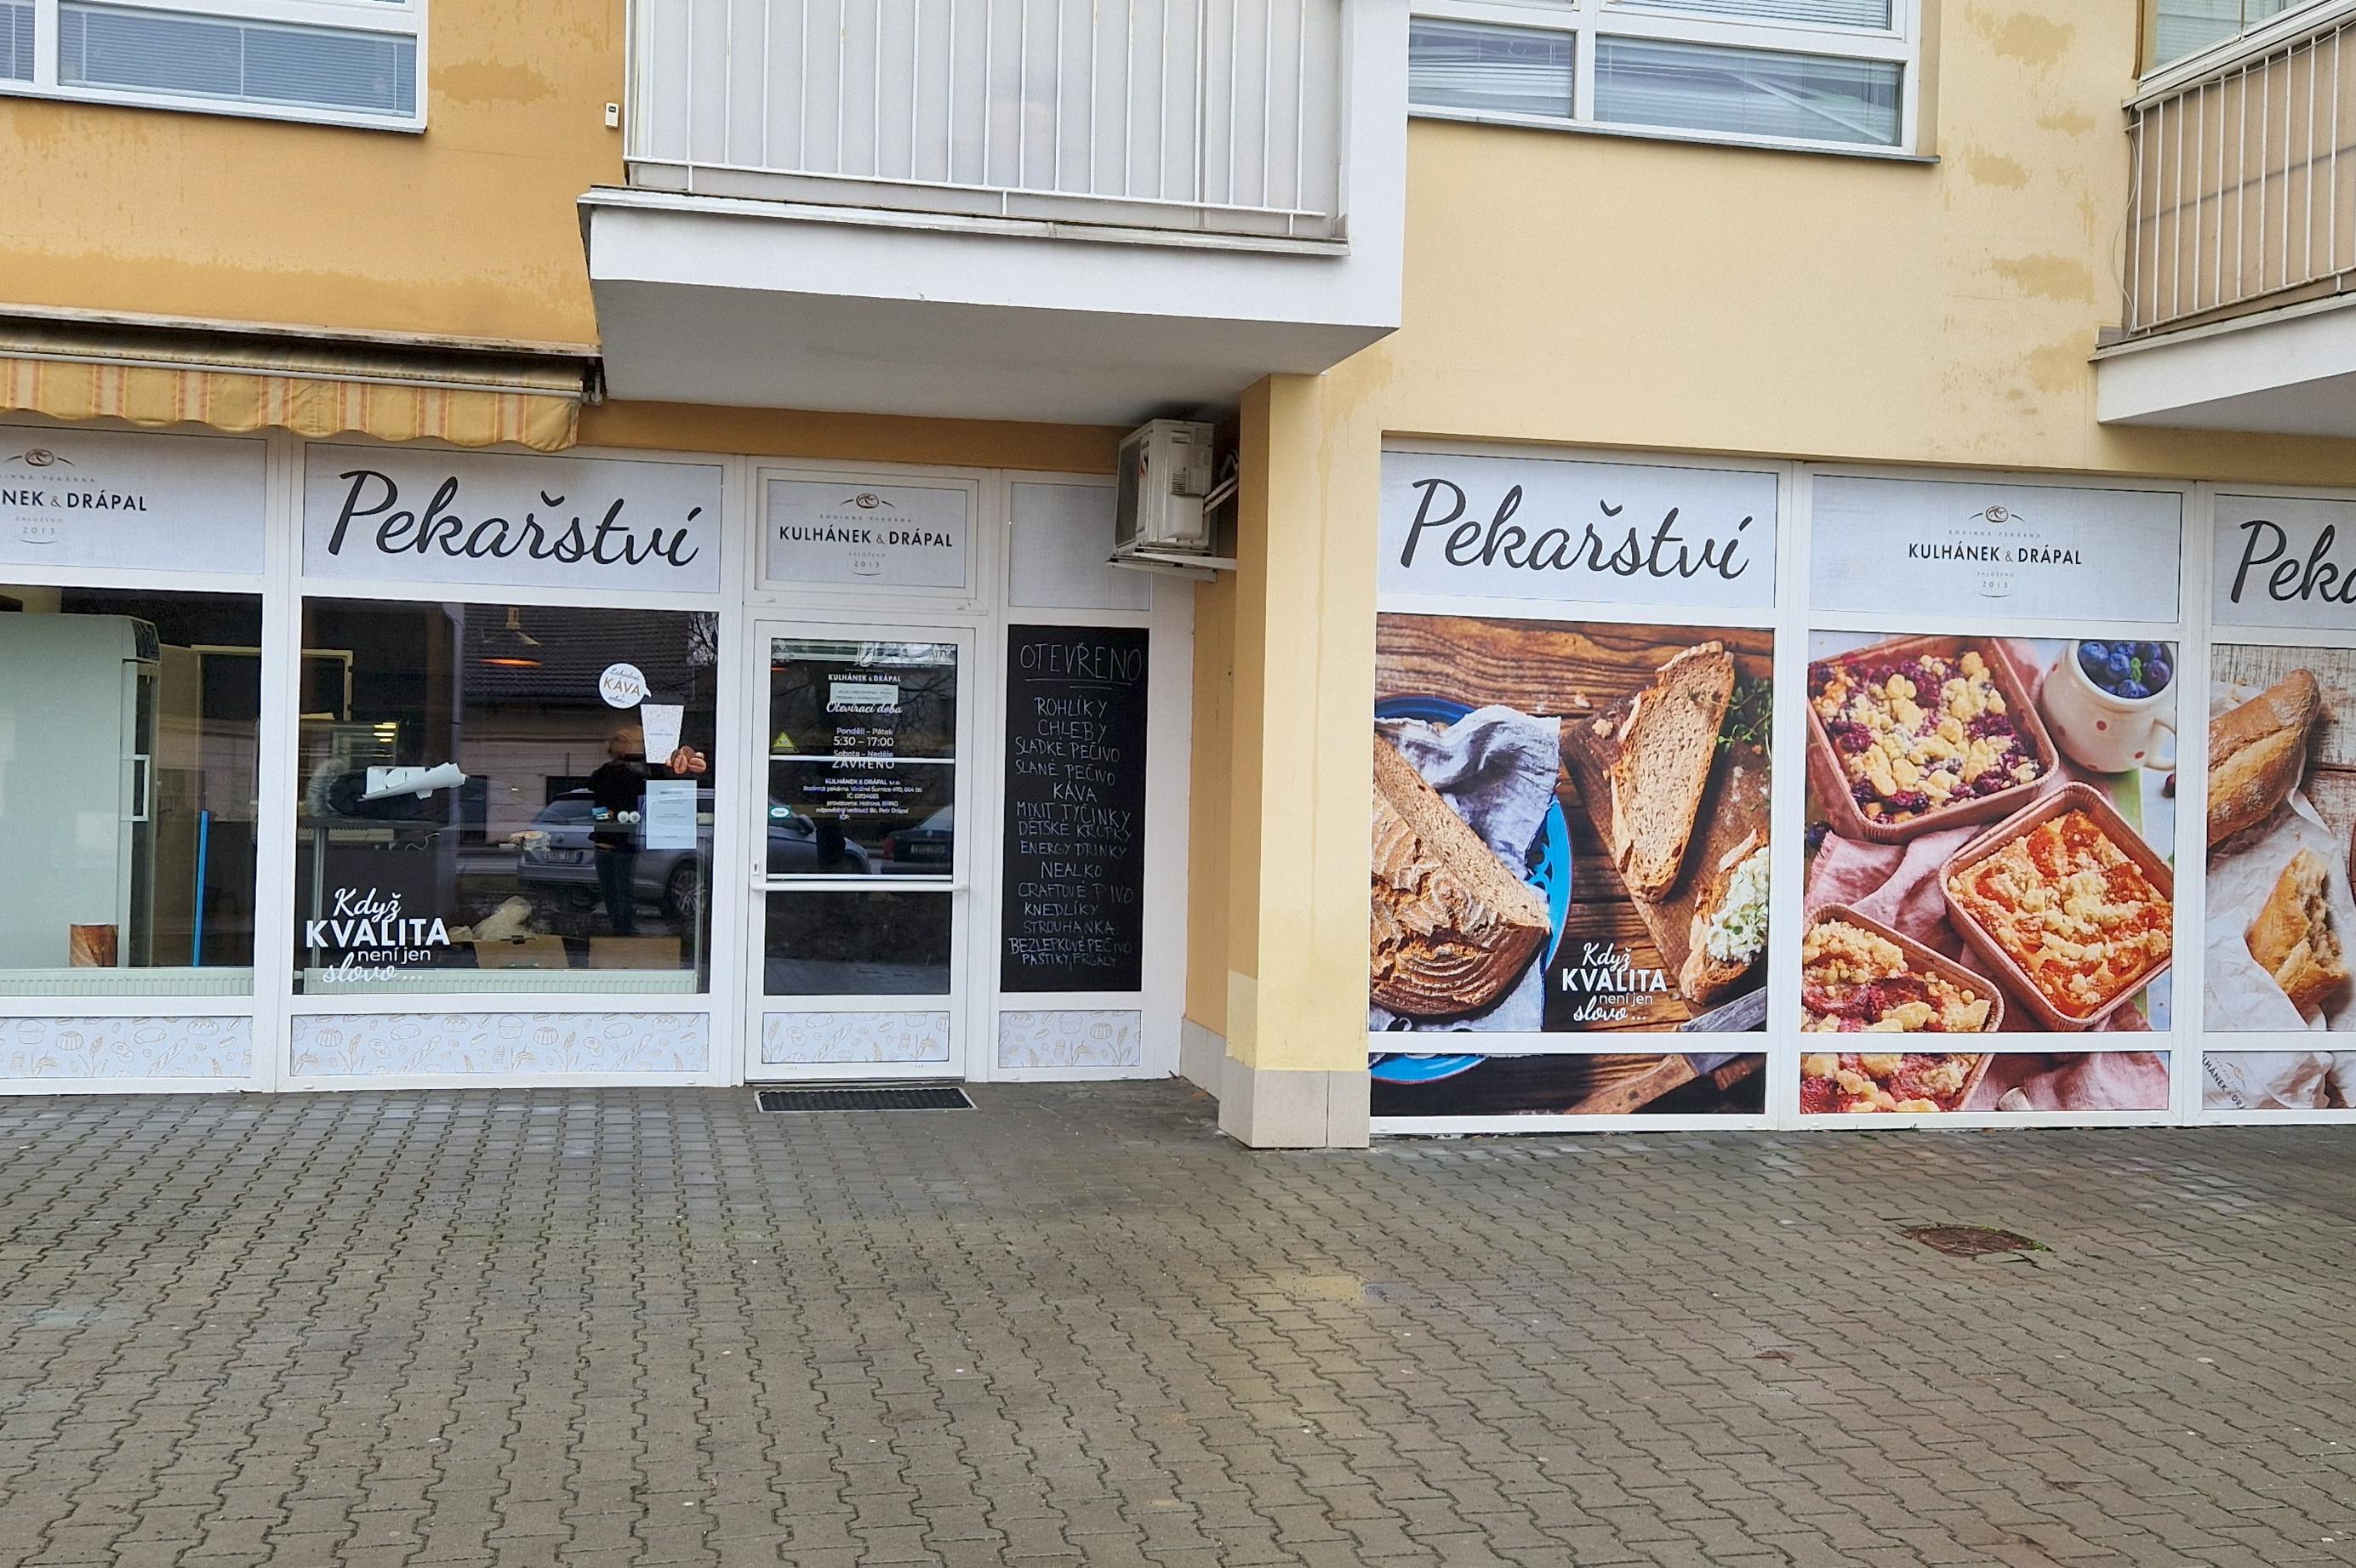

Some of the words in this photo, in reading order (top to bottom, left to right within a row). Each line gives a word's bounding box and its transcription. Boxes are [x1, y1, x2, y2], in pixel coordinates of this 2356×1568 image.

[50, 495, 62, 508] &
[67, 489, 147, 511] DRÁPAL
[328, 470, 703, 567] Pekařství
[1400, 478, 1754, 579] Pekařství
[780, 524, 871, 544] KULHÁNEK
[876, 533, 885, 545] &
[889, 528, 953, 547] DRÁPAL
[1908, 541, 1999, 562] KULHÁNEK
[2005, 550, 2014, 562] &
[2018, 545, 2082, 565] DRÁPAL
[1021, 642, 1142, 681] OTEVŘENO
[603, 676, 640, 696] KÁVA
[828, 672, 867, 681] KULHÁNEK
[874, 674, 901, 682] DRÁPAL
[826, 701, 875, 713] Otevírací
[876, 702, 903, 714] doba
[1034, 694, 1107, 718] ROHLÍKY
[833, 736, 856, 746] 5:30
[867, 737, 894, 746] 17:00
[1015, 737, 1067, 756] SLADKÉ
[1070, 742, 1120, 762] PEČIVO
[1015, 759, 1058, 776] SLANÉ
[1064, 764, 1115, 786] PEČIVO
[1053, 780, 1097, 802] KÁVA
[1016, 801, 1055, 819] MIXIT
[1061, 803, 1132, 830] TYČINKY
[1021, 841, 1071, 855] ENERGY
[1075, 843, 1127, 859] DRINKY
[1041, 861, 1103, 879] NEALKO
[1092, 883, 1133, 904] PIVO
[334, 887, 402, 923] Když
[1024, 900, 1098, 917] KNEDLÍKY
[305, 917, 451, 949] KVALITA
[1023, 920, 1115, 935] STROUHANKA
[1008, 934, 1086, 954] BEZLEPKOVÉ
[357, 946, 399, 962] není
[401, 946, 431, 965] jen
[1581, 942, 1633, 972] Když
[1562, 967, 1668, 993] KVALITA
[1599, 993, 1629, 1005] není
[1632, 993, 1653, 1007] jen
